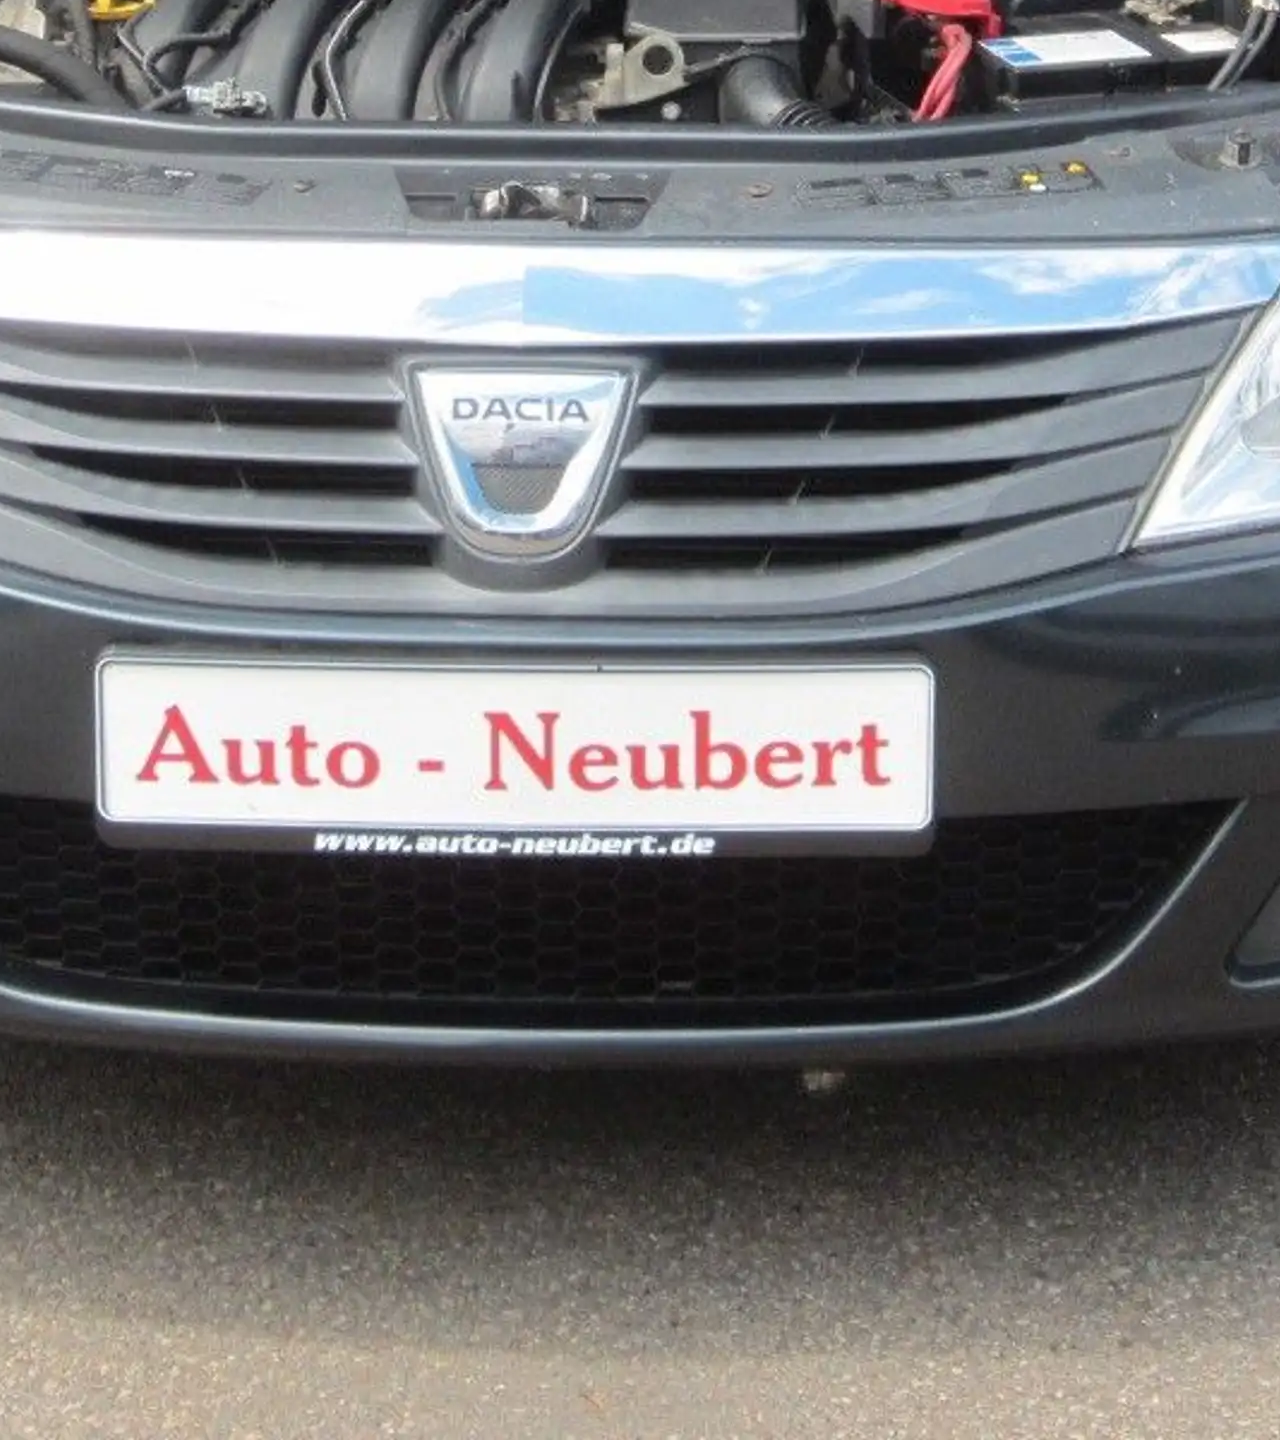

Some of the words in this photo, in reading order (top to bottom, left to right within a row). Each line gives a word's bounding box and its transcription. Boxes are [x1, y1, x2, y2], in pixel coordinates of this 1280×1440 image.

[452, 397, 589, 422] DACIA
[138, 706, 381, 789] Auto
[418, 759, 443, 772] -
[485, 709, 888, 791] Neubert
[313, 832, 717, 857] www.auto-neubert.de
